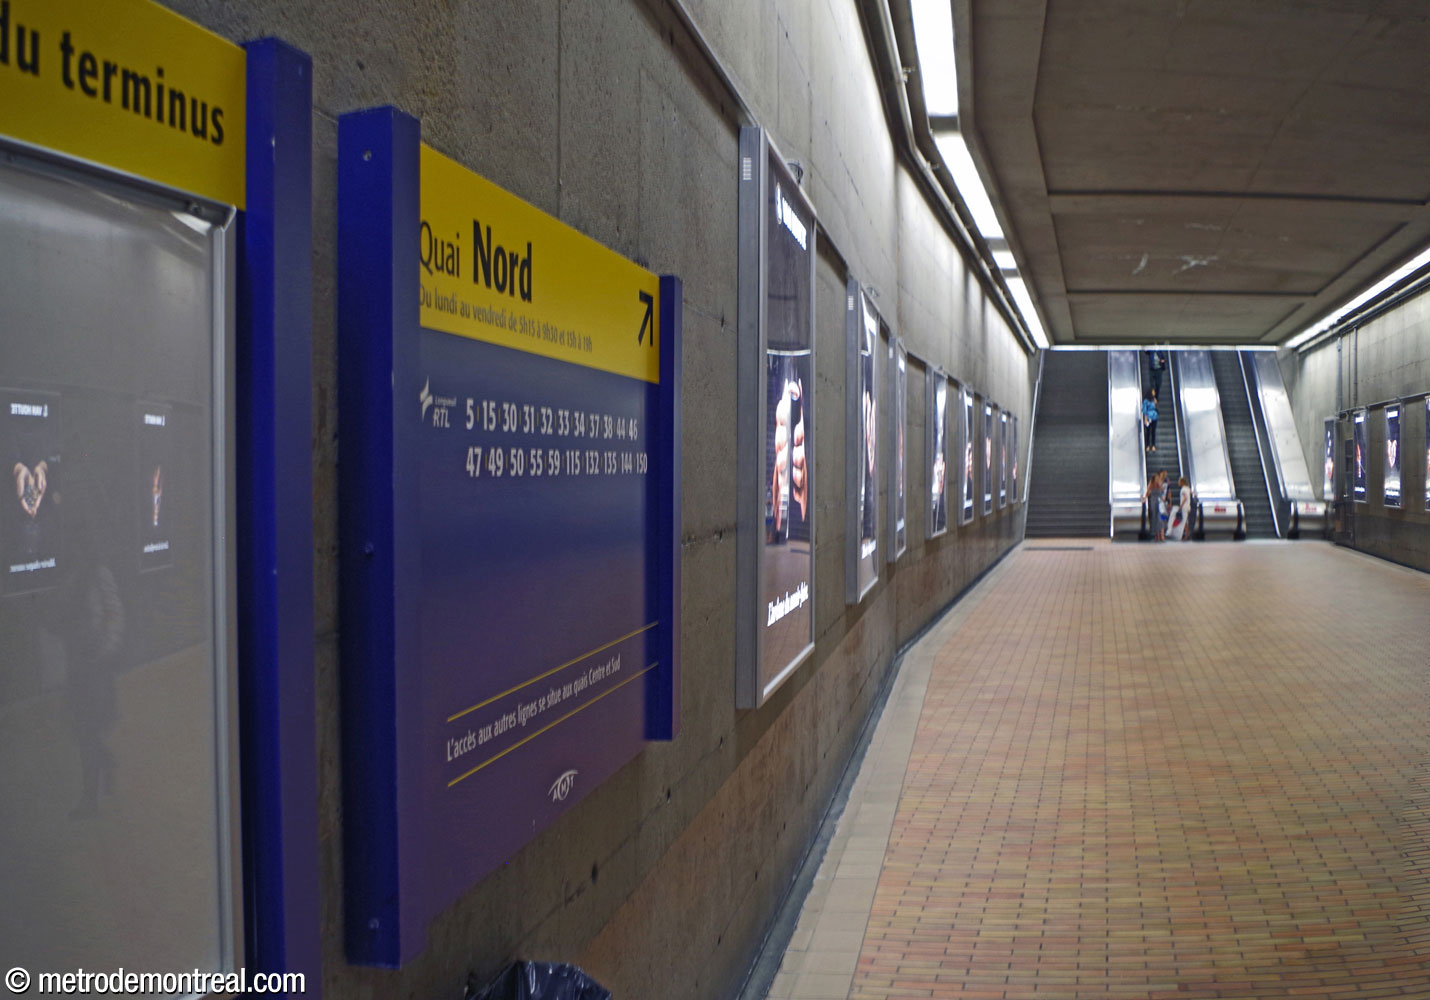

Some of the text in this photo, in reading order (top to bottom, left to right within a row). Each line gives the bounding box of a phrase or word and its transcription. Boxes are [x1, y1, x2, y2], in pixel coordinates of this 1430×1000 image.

[59, 31, 225, 146] terminus
[420, 218, 532, 303] Quai Nord
[420, 284, 431, 308] Du
[435, 287, 457, 315] lundi
[460, 301, 470, 319] au
[473, 304, 506, 329] vendredi
[508, 311, 517, 332] de
[519, 315, 535, 338] 5h15
[542, 321, 558, 344] 9h30
[432, 407, 450, 429] RTL
[466, 397, 475, 430] 5
[482, 399, 497, 432] 15
[502, 401, 518, 433] 30
[523, 403, 535, 434] 31
[540, 405, 553, 435] 32
[558, 408, 570, 436] 33
[574, 410, 585, 438] 34
[589, 412, 600, 439] 37
[603, 413, 613, 440] 38
[616, 416, 625, 440] 44
[628, 417, 638, 441] 46
[466, 445, 648, 478] 47 49 50 55 59 115 132 135 144 150
[447, 651, 621, 762] L'accès aux autres lignes se situe aux quais Centre et Sud
